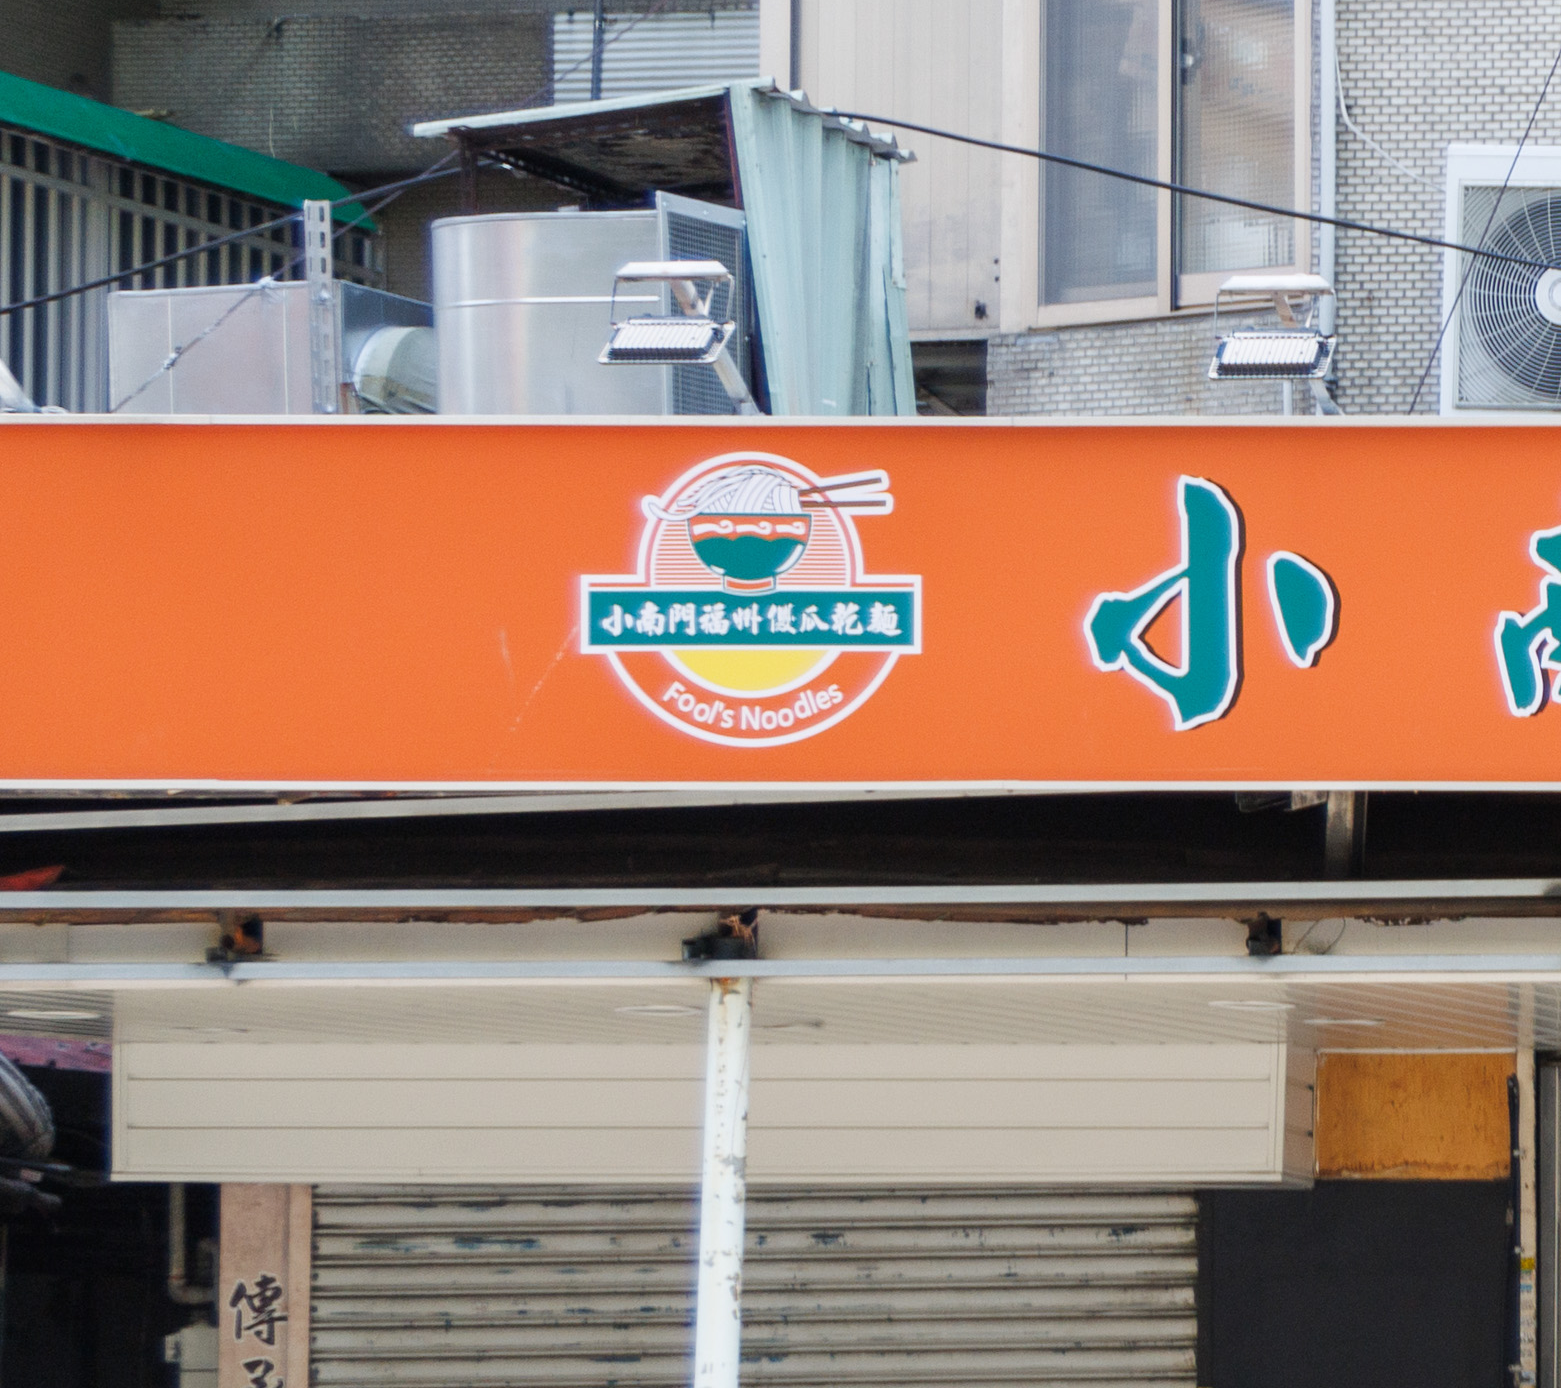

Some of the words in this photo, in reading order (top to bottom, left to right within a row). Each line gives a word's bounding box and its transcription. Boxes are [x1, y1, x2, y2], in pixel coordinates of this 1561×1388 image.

[601, 600, 903, 637] 小南門福州傻瓜乾麵
[662, 680, 735, 729] Fool's
[740, 683, 844, 731] Noodles
